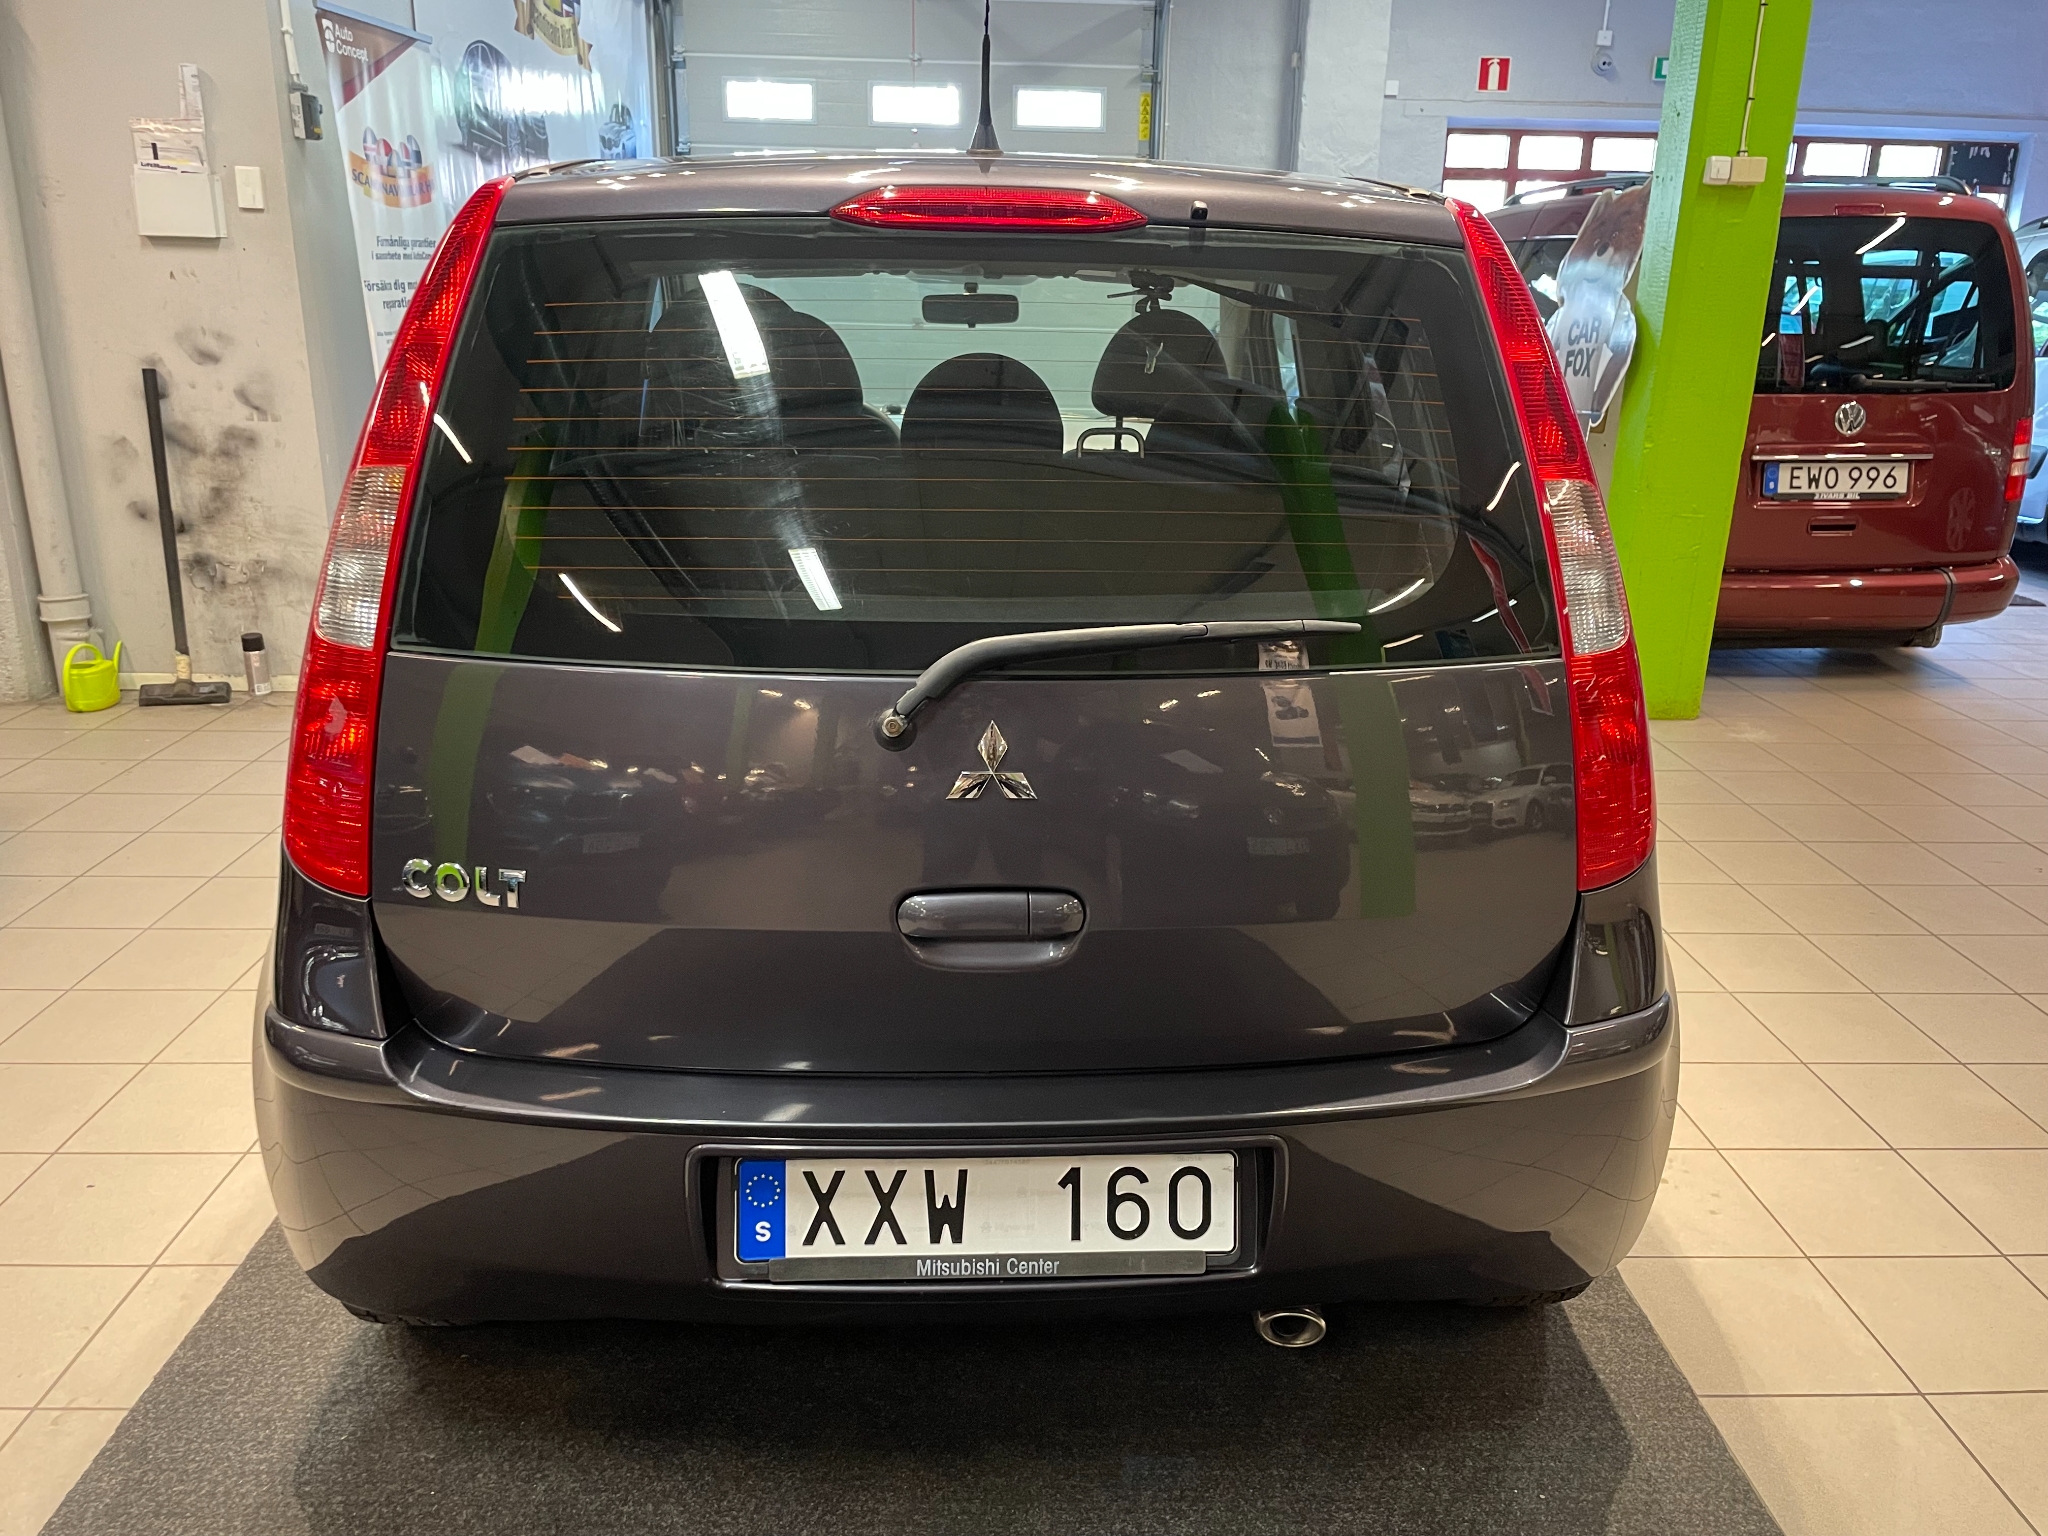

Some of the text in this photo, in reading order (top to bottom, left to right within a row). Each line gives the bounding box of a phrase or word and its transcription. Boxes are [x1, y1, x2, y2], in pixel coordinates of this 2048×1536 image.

[334, 23, 354, 42] Auto
[335, 39, 369, 62] Concept
[393, 279, 406, 293] dig
[1567, 318, 1602, 346] CAR
[1563, 347, 1596, 378] FOX
[1789, 466, 1897, 490] EWO 996
[402, 858, 527, 909] COLT
[802, 1165, 1212, 1246] XXW 160
[755, 1221, 771, 1242] S
[916, 1257, 1060, 1276] Mitsubishi Center
